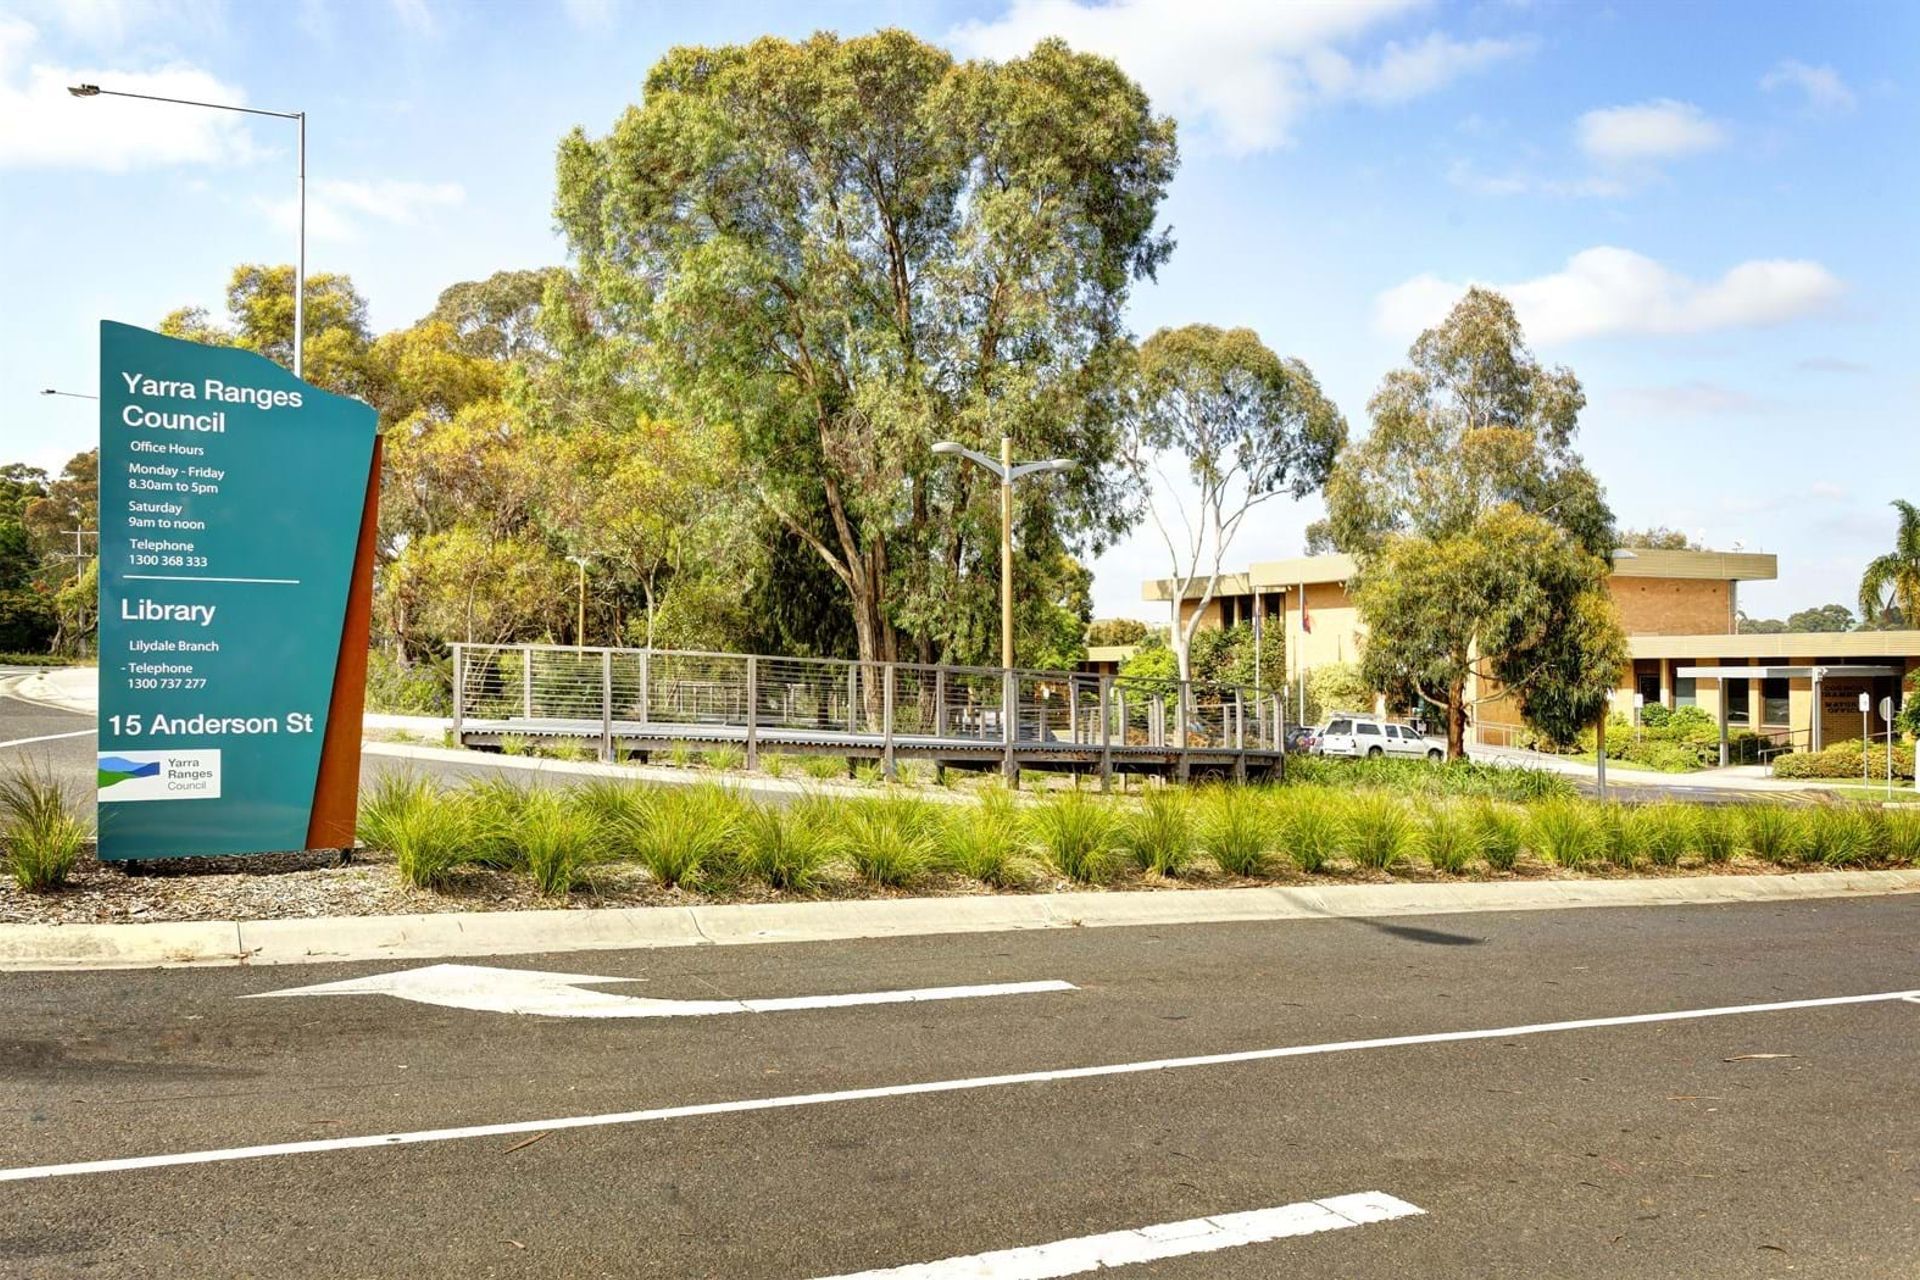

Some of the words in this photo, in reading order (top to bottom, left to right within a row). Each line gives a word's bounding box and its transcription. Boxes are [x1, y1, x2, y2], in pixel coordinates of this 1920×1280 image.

[121, 371, 197, 400] Yarra
[204, 378, 304, 410] Ranges
[122, 404, 226, 433] Council
[130, 440, 167, 454] Office
[168, 443, 205, 456] Hours
[128, 462, 179, 479] Monday
[188, 466, 225, 481] Friday
[128, 478, 174, 491] 8.30am
[175, 482, 190, 493] to
[191, 481, 219, 495] 5pm
[128, 500, 183, 516] Saturday
[128, 516, 156, 528] 9am
[157, 518, 172, 529] to
[173, 520, 206, 530] noon
[129, 538, 195, 553] Telephone
[129, 554, 160, 566] 1300
[161, 555, 184, 567] 368
[186, 556, 208, 567] 333
[121, 598, 217, 627] Library
[129, 639, 177, 654] Lilydale
[177, 640, 220, 652] Branch
[128, 662, 194, 676] Telephone
[127, 678, 158, 689] 1300
[160, 678, 182, 690] 737
[184, 678, 207, 689] 277
[108, 714, 142, 736] 15
[149, 712, 278, 736] Anderson
[285, 712, 314, 734] St
[168, 758, 200, 768] Yarra
[168, 769, 213, 780] Ranges
[168, 781, 207, 791] Council
